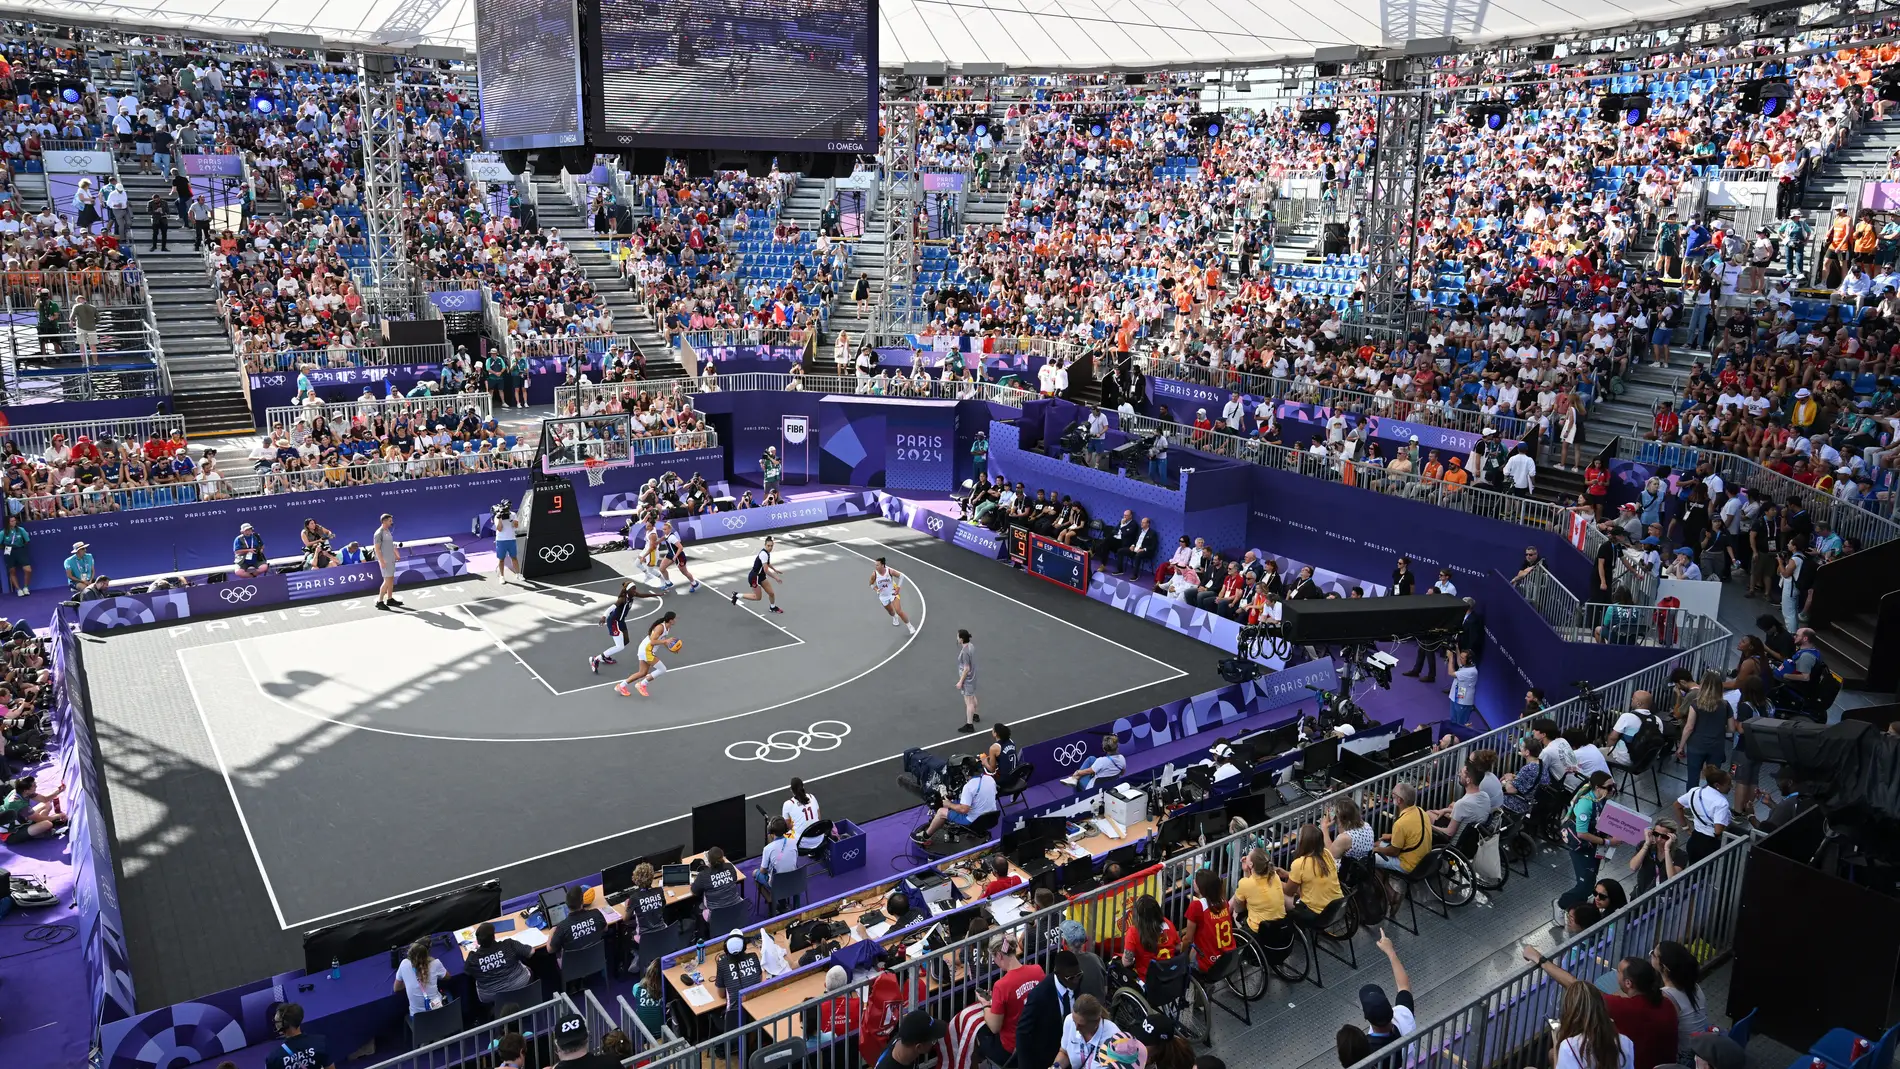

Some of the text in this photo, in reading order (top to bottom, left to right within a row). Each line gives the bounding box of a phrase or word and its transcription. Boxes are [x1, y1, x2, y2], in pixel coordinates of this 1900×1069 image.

[836, 142, 864, 151] OMEGA
[1193, 389, 1219, 402] 2024
[786, 424, 804, 434] FIBA
[1441, 434, 1476, 449] PARI
[897, 448, 942, 462] 2024
[553, 495, 562, 509] 9
[799, 507, 823, 518] 2024
[978, 537, 997, 551] 2024
[1018, 541, 1025, 557] 9
[1044, 543, 1054, 552] ESP
[1037, 553, 1044, 563] 4
[1062, 550, 1074, 559] USA
[1072, 565, 1079, 576] 6
[339, 572, 374, 585] 2024
[340, 585, 465, 611] 224
[1304, 670, 1331, 685] 2024
[802, 806, 814, 821] 11
[711, 876, 733, 888] 2024
[640, 901, 663, 913] 2024
[572, 925, 597, 940] 2024
[1215, 920, 1231, 949] 13
[480, 958, 506, 973] 2024
[729, 958, 755, 972] PRIS
